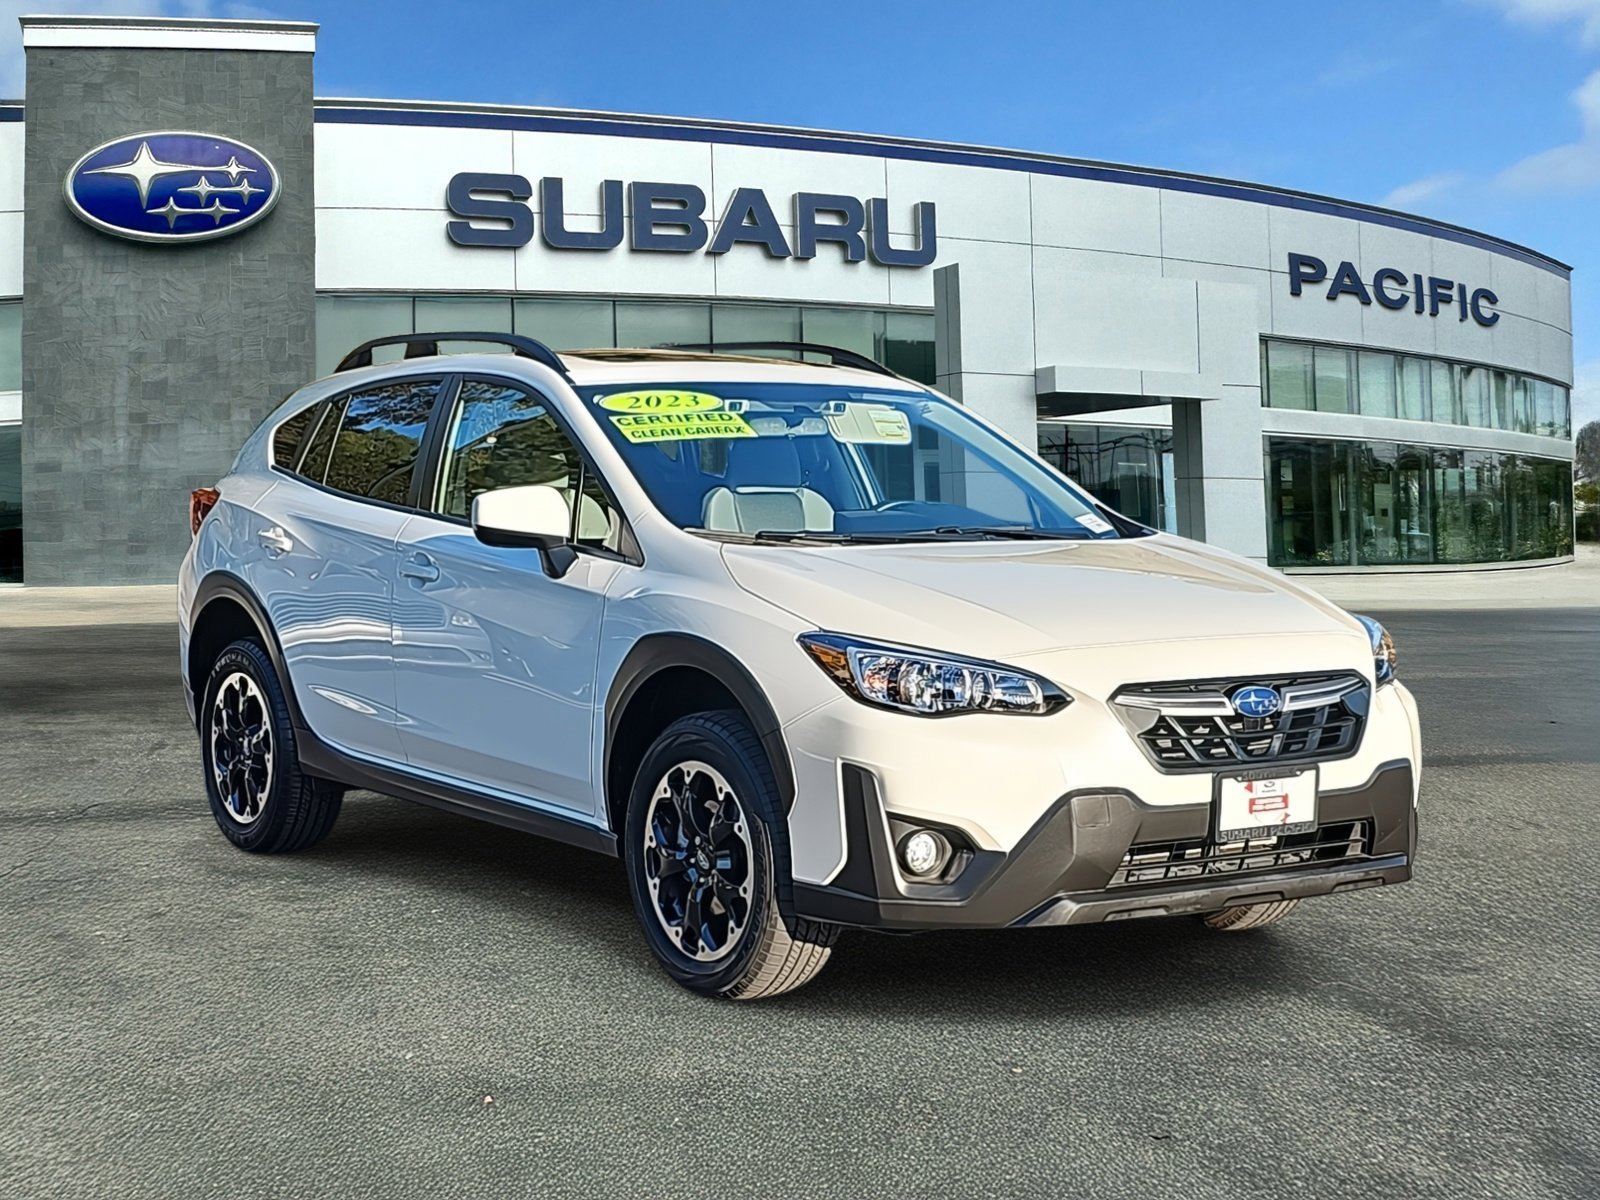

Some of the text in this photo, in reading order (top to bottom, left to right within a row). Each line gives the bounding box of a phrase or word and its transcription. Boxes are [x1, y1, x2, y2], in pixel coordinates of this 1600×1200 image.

[446, 171, 938, 268] SUBARU
[1288, 252, 1501, 327] PACIFIC
[627, 394, 700, 409] 2023
[616, 413, 733, 426] CERTIFIED
[631, 428, 681, 439] CLEAN
